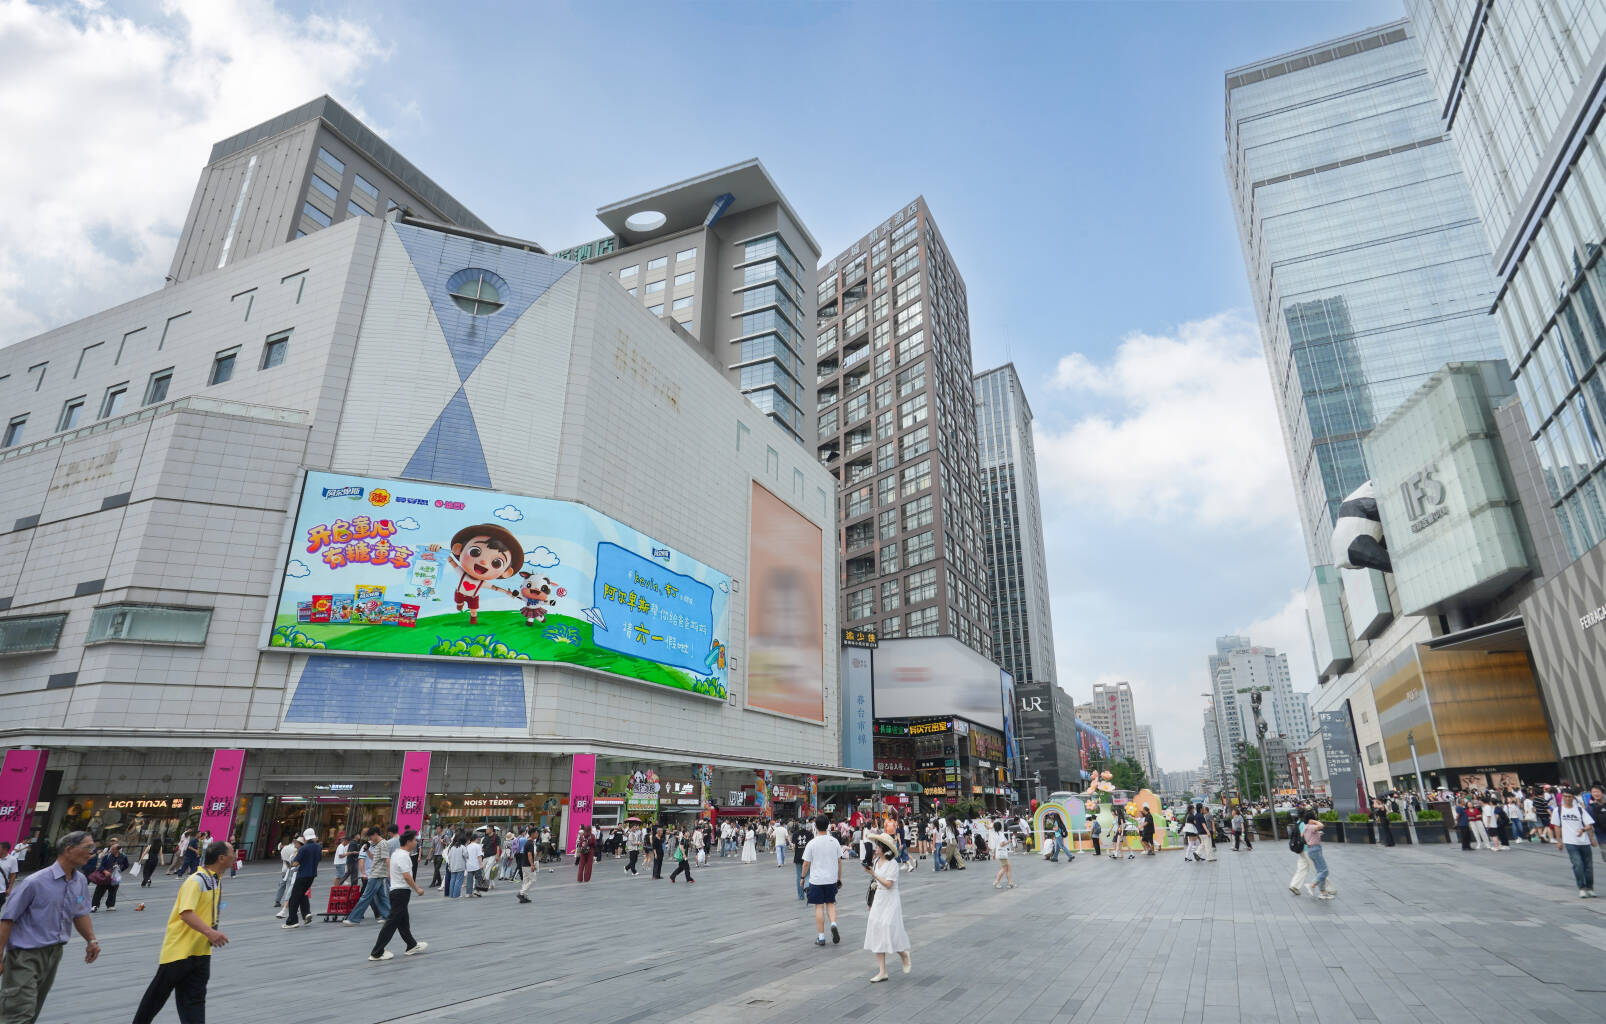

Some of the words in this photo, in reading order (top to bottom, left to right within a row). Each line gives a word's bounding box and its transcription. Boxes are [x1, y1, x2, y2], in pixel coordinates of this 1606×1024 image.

[1400, 463, 1446, 521] IFS
[307, 516, 397, 553] 开启童心
[1021, 696, 1044, 711] UR
[212, 803, 225, 811] BF
[405, 801, 417, 809] BF
[577, 800, 587, 808] BF
